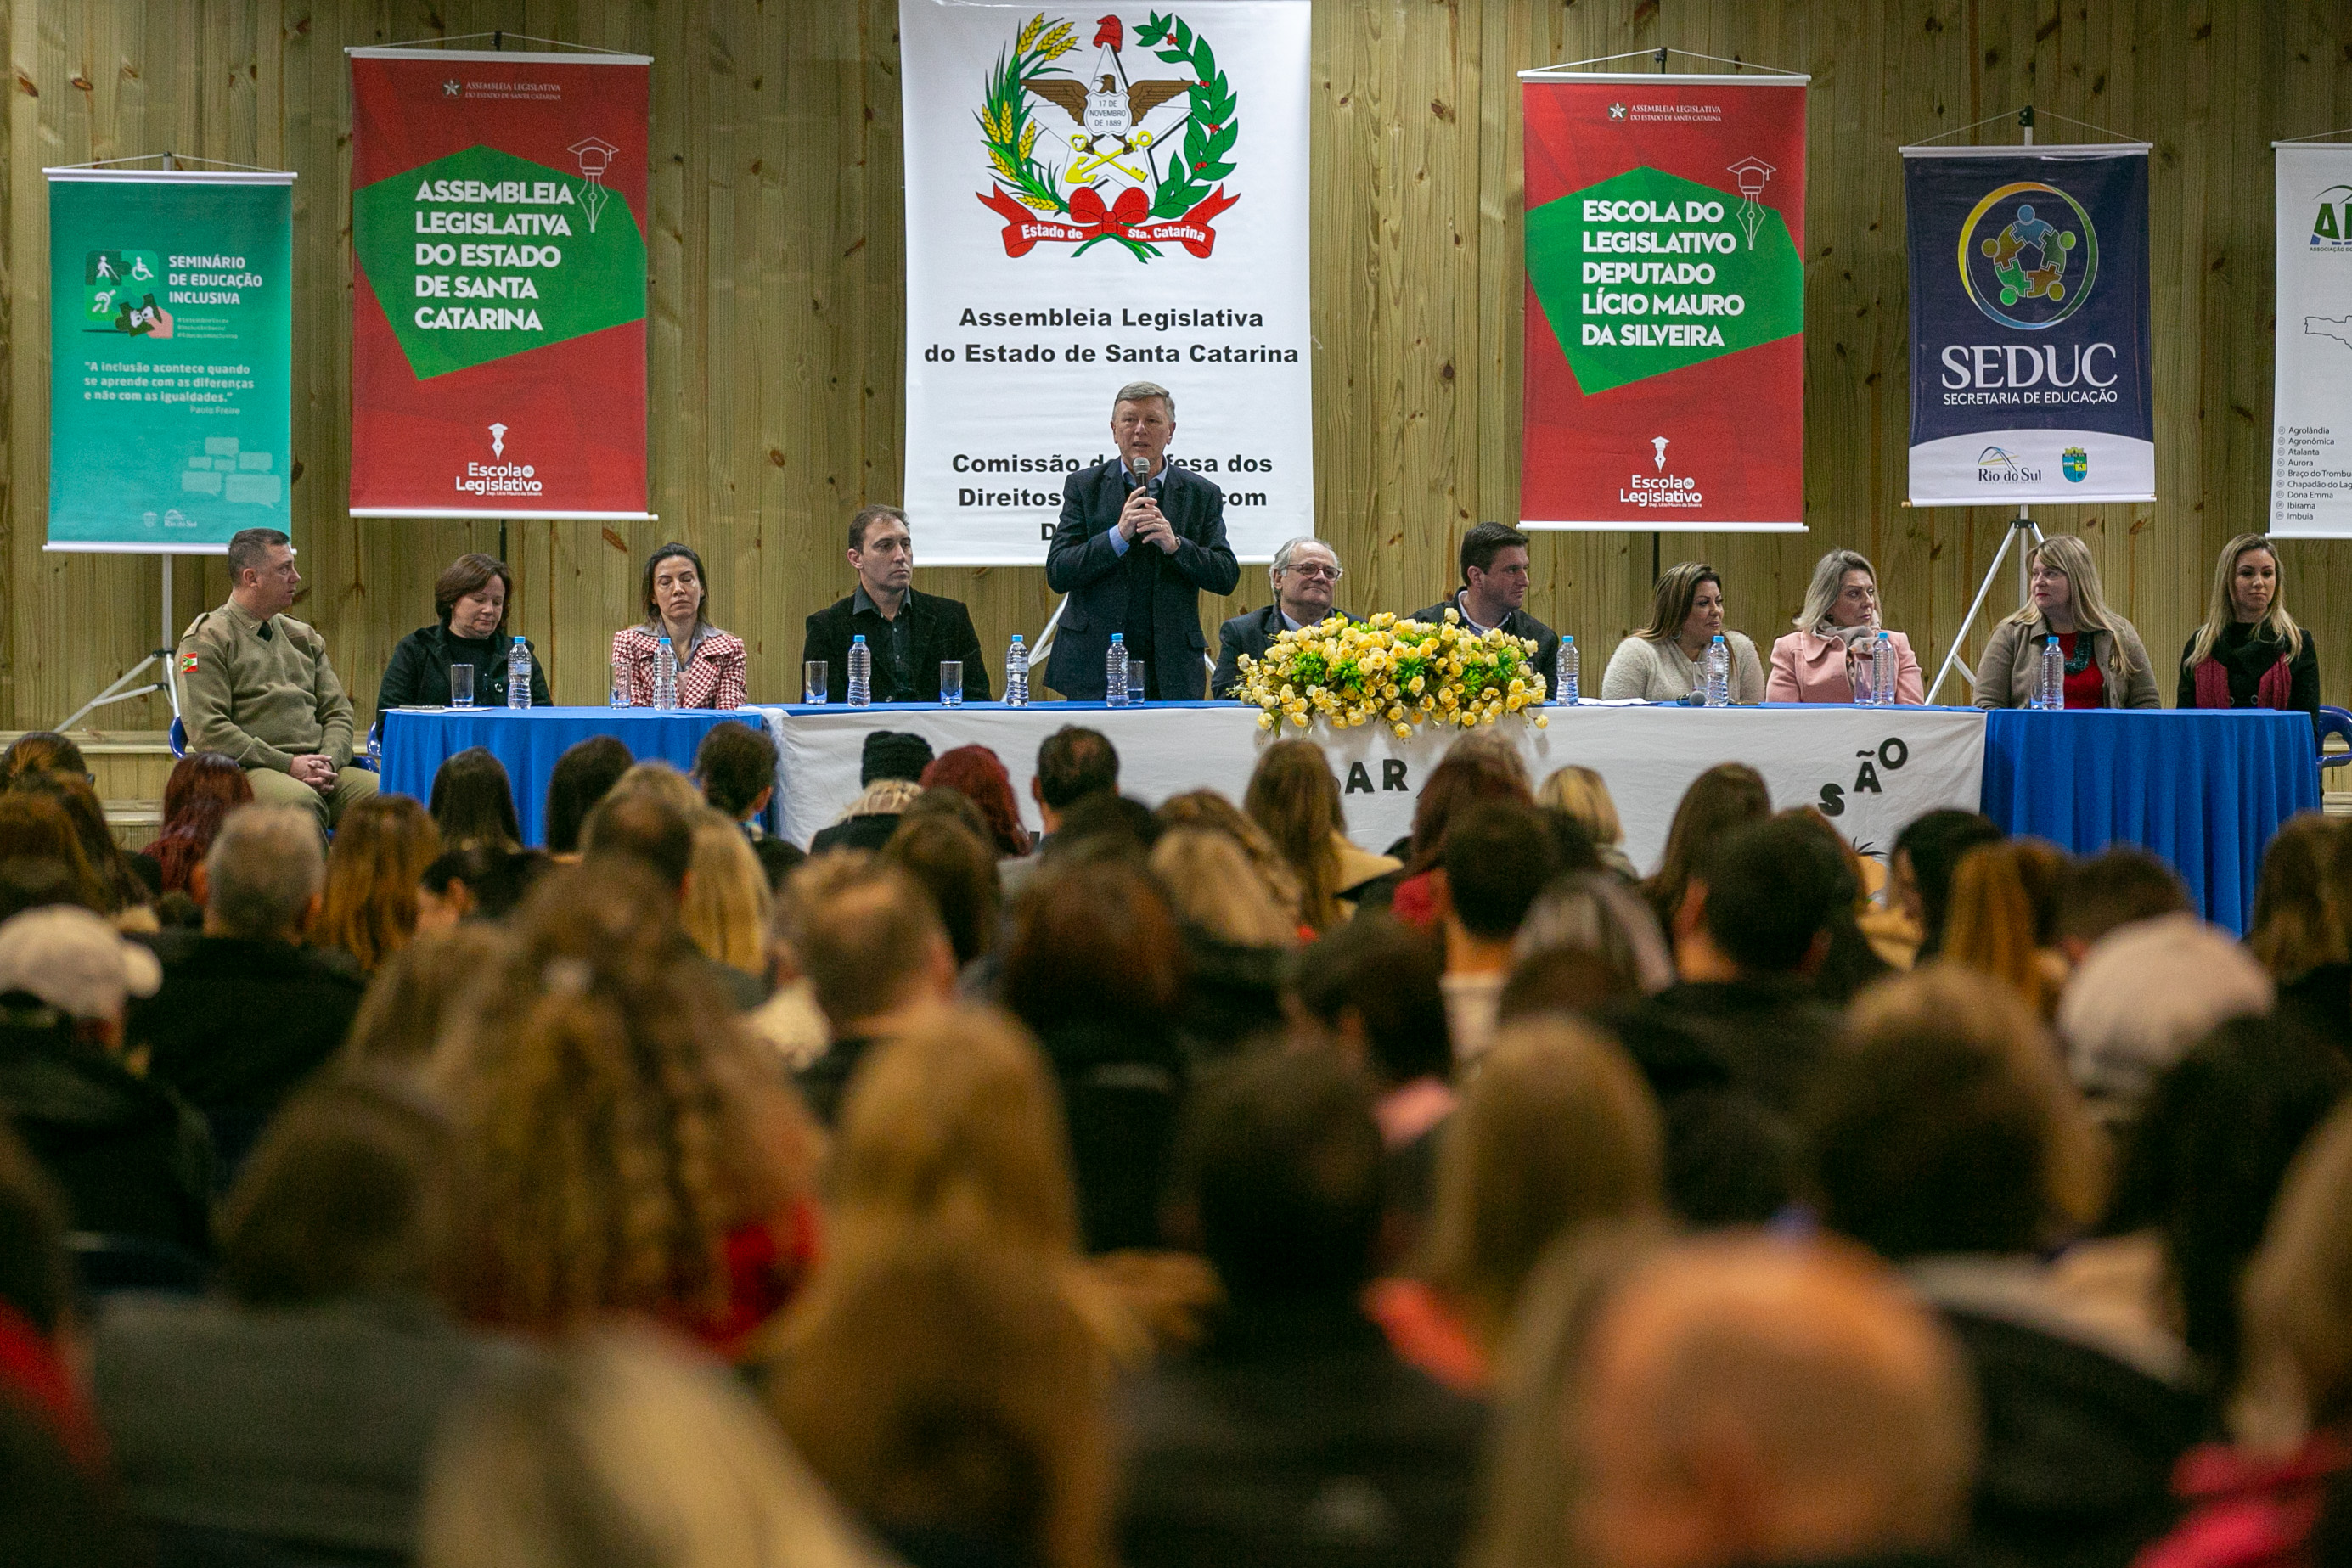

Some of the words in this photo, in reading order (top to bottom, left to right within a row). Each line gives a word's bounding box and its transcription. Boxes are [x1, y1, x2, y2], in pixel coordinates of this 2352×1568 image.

[1631, 104, 1674, 113] ASSEMBLEIA
[414, 180, 575, 205] ASSEMBLEIA
[1583, 200, 1681, 222] ESCOLA
[1686, 201, 1724, 222] DO
[415, 211, 572, 237] LEGISLATIVA
[1021, 224, 1065, 239] Estado
[1068, 228, 1083, 239] de
[1128, 228, 1151, 239] Sta.
[1153, 225, 1206, 242] Catarina
[1583, 231, 1736, 254] LEGISLATIVO
[169, 253, 245, 269] SEMINÁRIO
[415, 243, 457, 267] DO
[461, 244, 562, 268] ESTADO
[169, 273, 187, 286] DE
[191, 272, 262, 289] EDUCAÇÃO
[1583, 262, 1716, 284] DEPUTADO
[415, 275, 450, 297] DE
[453, 276, 539, 300] SANTA
[169, 291, 240, 305] INCLUSIVA
[1583, 287, 1648, 315] LÍCIO
[1652, 294, 1745, 316] MAURO
[414, 306, 543, 331] CATARINA
[959, 308, 1111, 327] Assembleia
[1123, 308, 1263, 332] Legislativa
[1582, 323, 1617, 346] DA
[1620, 324, 1725, 346] SILVEIRA
[924, 344, 955, 362] do
[965, 344, 1055, 362] Estado
[1065, 344, 1096, 362] de
[1106, 344, 1179, 362] Santa
[1190, 344, 1298, 362] Catarina
[101, 362, 150, 373] inclusão
[153, 363, 205, 374] acontece
[207, 364, 250, 375] quando
[1941, 342, 2118, 390] SEDUC
[84, 378, 98, 386] se
[101, 377, 149, 388] aprende
[151, 379, 174, 387] com
[177, 379, 190, 387] as
[193, 377, 254, 390] diferenças
[84, 392, 92, 401] e
[94, 390, 115, 401] não
[118, 392, 142, 401] com
[144, 392, 158, 402] as
[1944, 391, 2020, 406] SECRETARIA
[2024, 391, 2040, 404] DE
[2045, 388, 2118, 405] EDUCAÇÃO
[2289, 426, 2330, 436] Agrolândia
[2288, 437, 2335, 447] Agronômica
[468, 462, 522, 477] Escola
[953, 453, 1080, 473] Comissão
[1228, 454, 1273, 473] dos
[2288, 458, 2313, 467] Aurora
[1631, 474, 1683, 489] Escola
[1978, 468, 2000, 481] Rio
[2004, 469, 2018, 481] do
[2021, 467, 2041, 481] Sul
[2288, 469, 2310, 479] Braço
[456, 475, 543, 496] Legislativo
[2287, 480, 2327, 489] Chapadão
[959, 488, 1061, 507] Direitos
[1620, 488, 1702, 507] Legislativo
[2287, 491, 2308, 499] Dona
[2310, 491, 2333, 499] Emma
[2287, 512, 2314, 520] Imbuia
